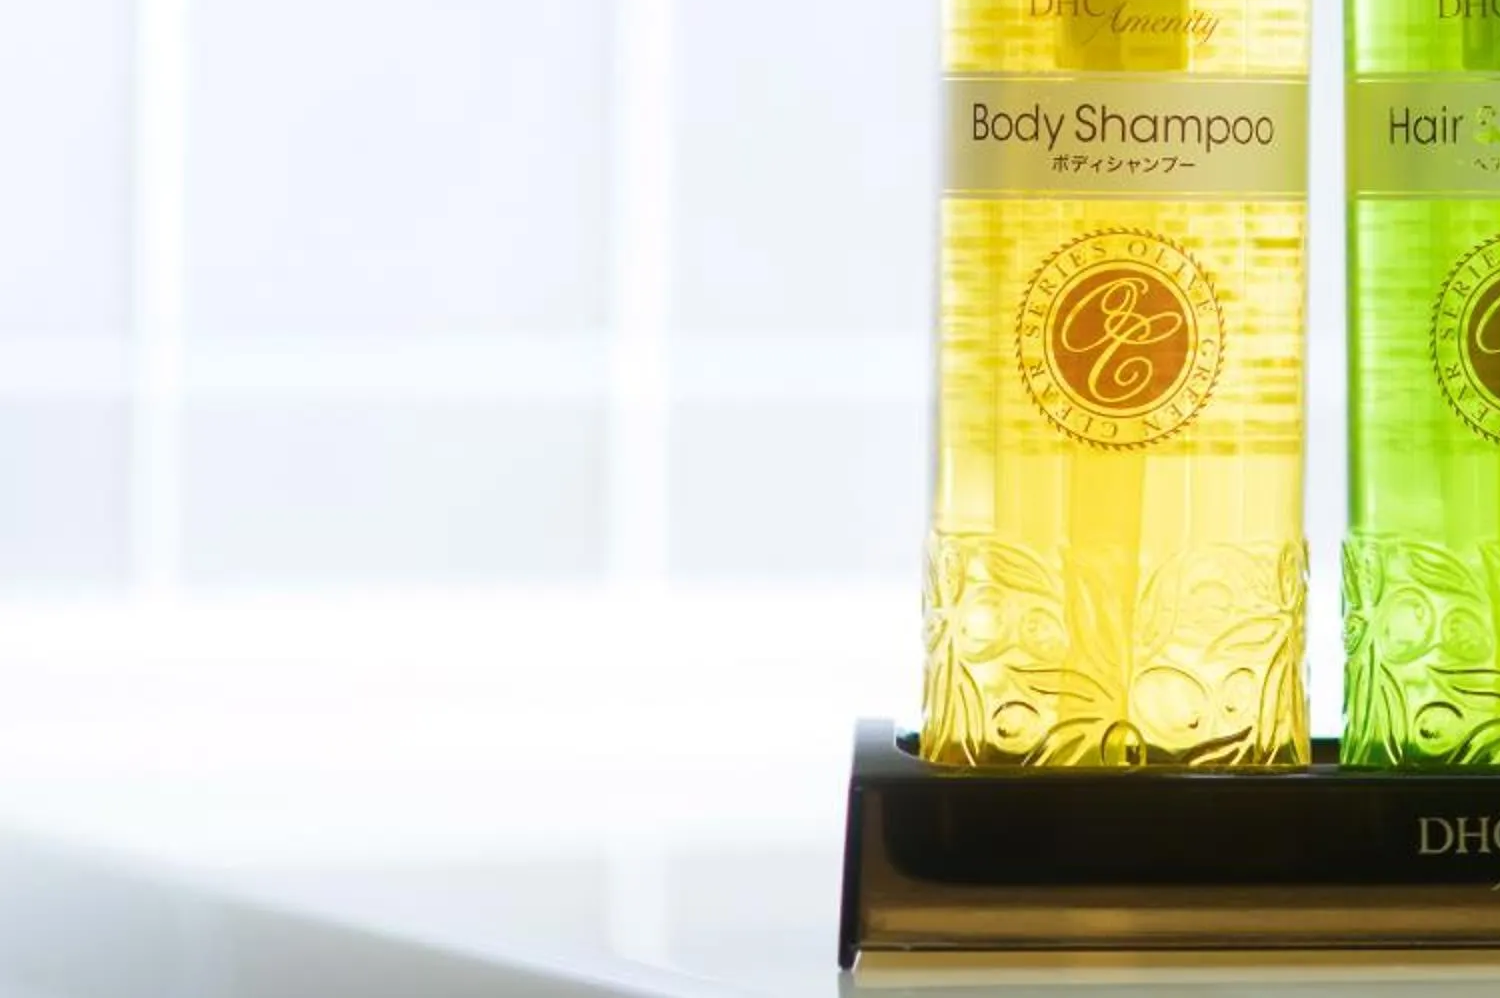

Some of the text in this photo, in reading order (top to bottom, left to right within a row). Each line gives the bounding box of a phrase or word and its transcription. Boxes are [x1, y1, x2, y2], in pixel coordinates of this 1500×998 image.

[1081, 0, 1221, 44] Amenity
[972, 103, 1275, 153] Body Shampoo
[1388, 105, 1464, 145] Hair
[1025, 240, 1107, 339] SERIES
